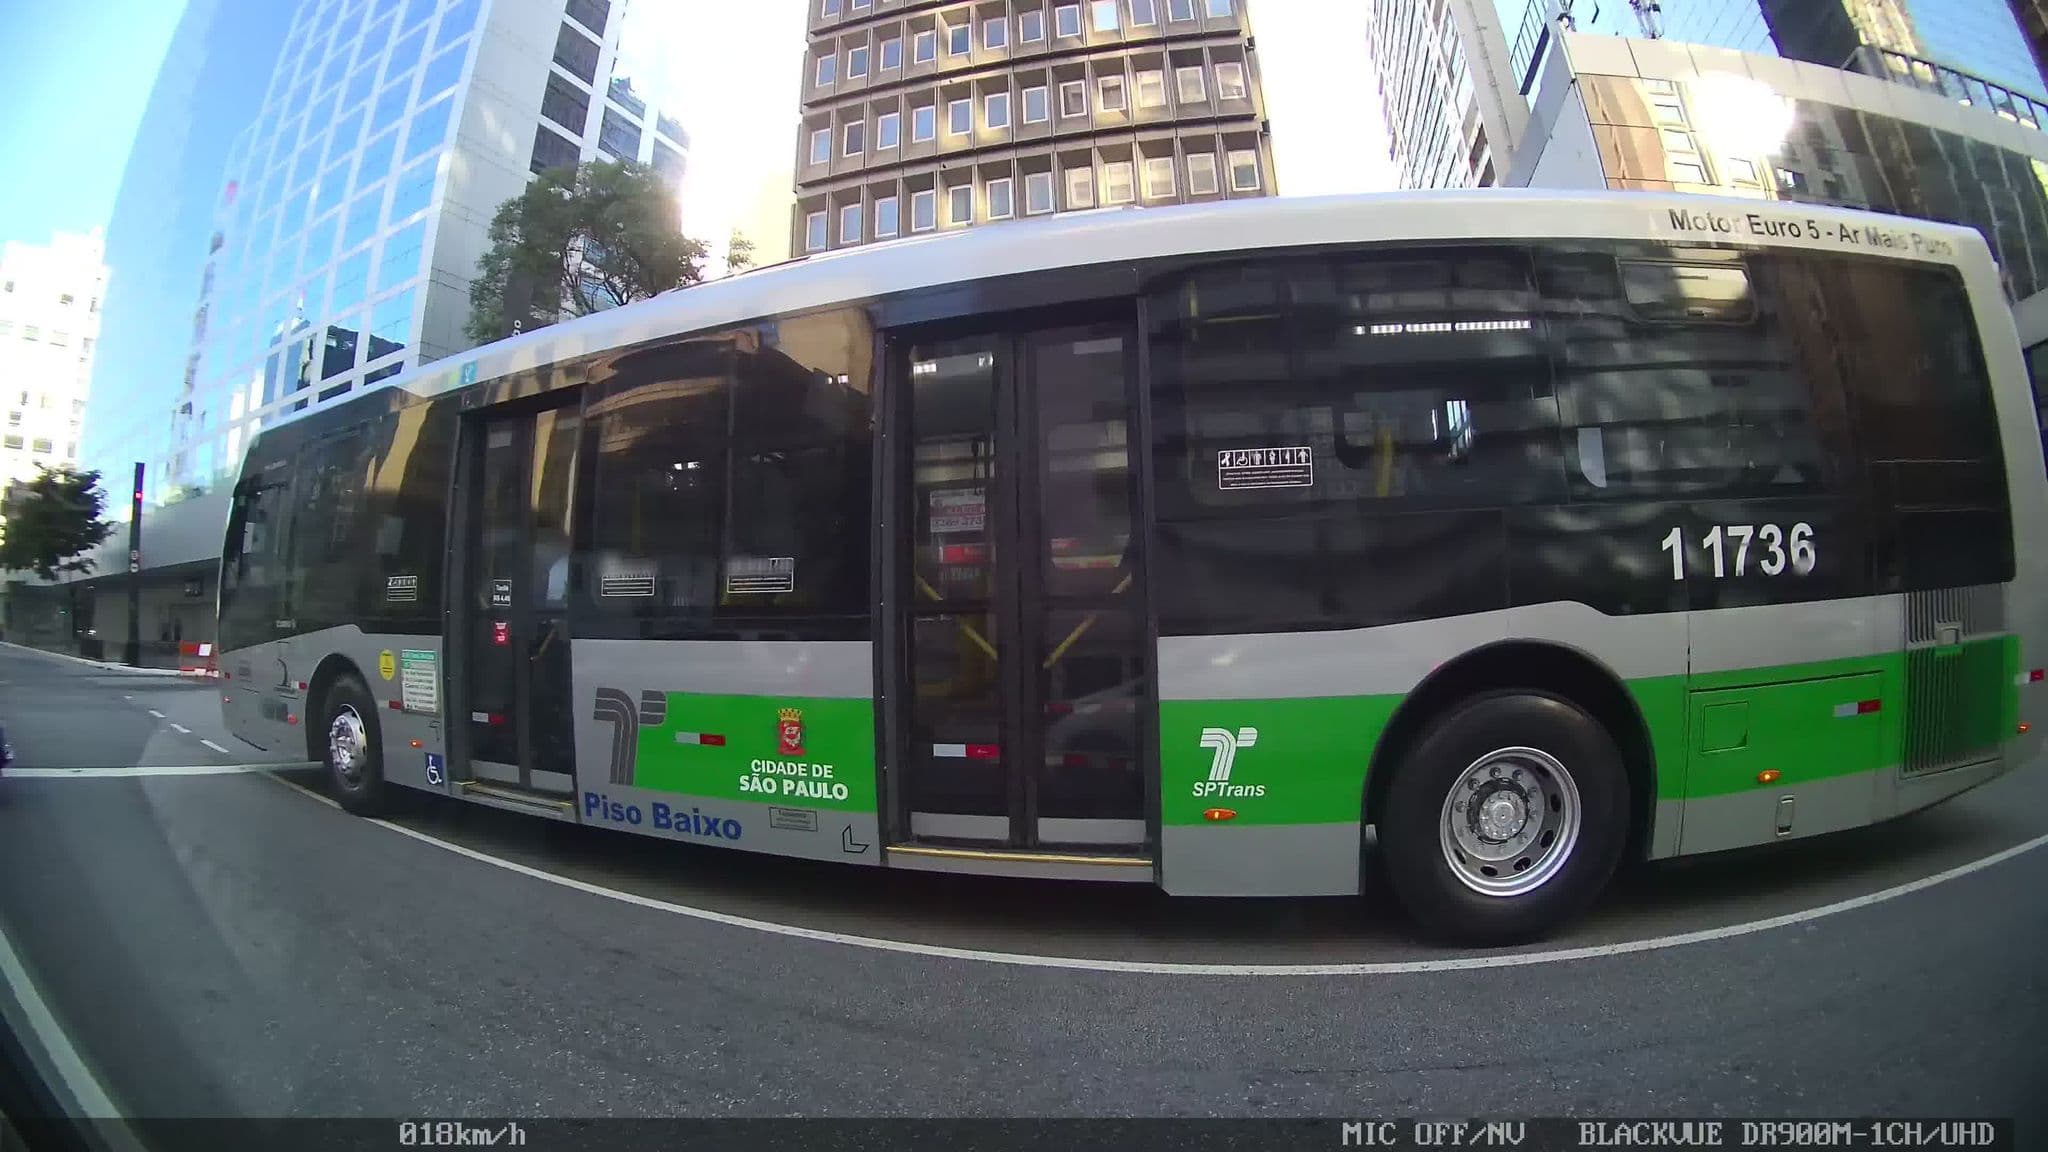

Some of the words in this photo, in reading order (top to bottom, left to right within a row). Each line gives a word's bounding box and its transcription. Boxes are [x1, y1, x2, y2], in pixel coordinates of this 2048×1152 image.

[1668, 207, 1739, 234] Motor
[1747, 213, 1801, 239] Euro
[1806, 218, 1821, 240] 5
[1839, 223, 1860, 245] Ar
[1865, 225, 1909, 251] Mais
[1912, 232, 1954, 257] Puro
[751, 759, 808, 777] CIDADE
[812, 764, 834, 779] DE
[739, 773, 777, 794] SÃO
[782, 778, 849, 801] PAULO
[1192, 781, 1266, 797] SPTrans
[584, 791, 643, 826] Piso
[652, 801, 743, 841] Baixo
